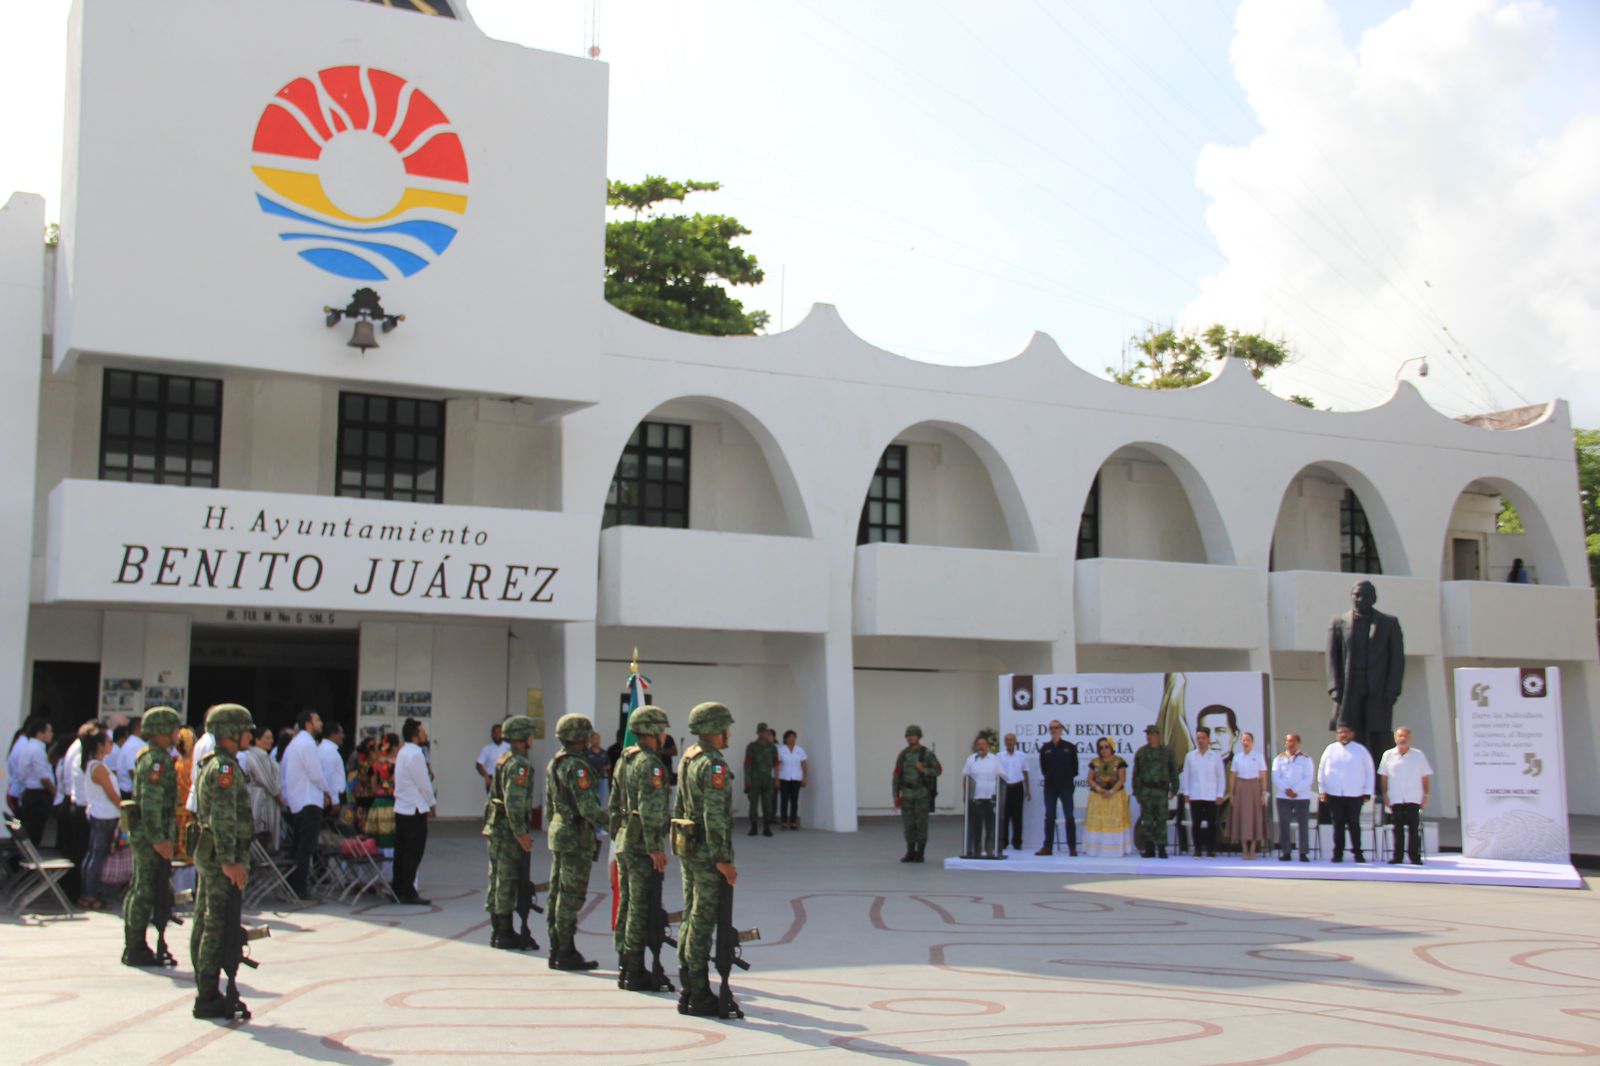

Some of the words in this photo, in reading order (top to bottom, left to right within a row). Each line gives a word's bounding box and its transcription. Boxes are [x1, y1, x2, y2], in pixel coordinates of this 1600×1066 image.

[201, 505, 235, 530] H.
[250, 508, 489, 547] Ayuntamiento
[112, 543, 324, 592] BENITO
[354, 554, 560, 603] JUÁREZ
[1042, 687, 1081, 705] 151
[1084, 696, 1135, 704] LUCTUOSO
[1015, 724, 1033, 736] DE
[1037, 724, 1070, 736] DN
[1075, 724, 1134, 736] BENITO
